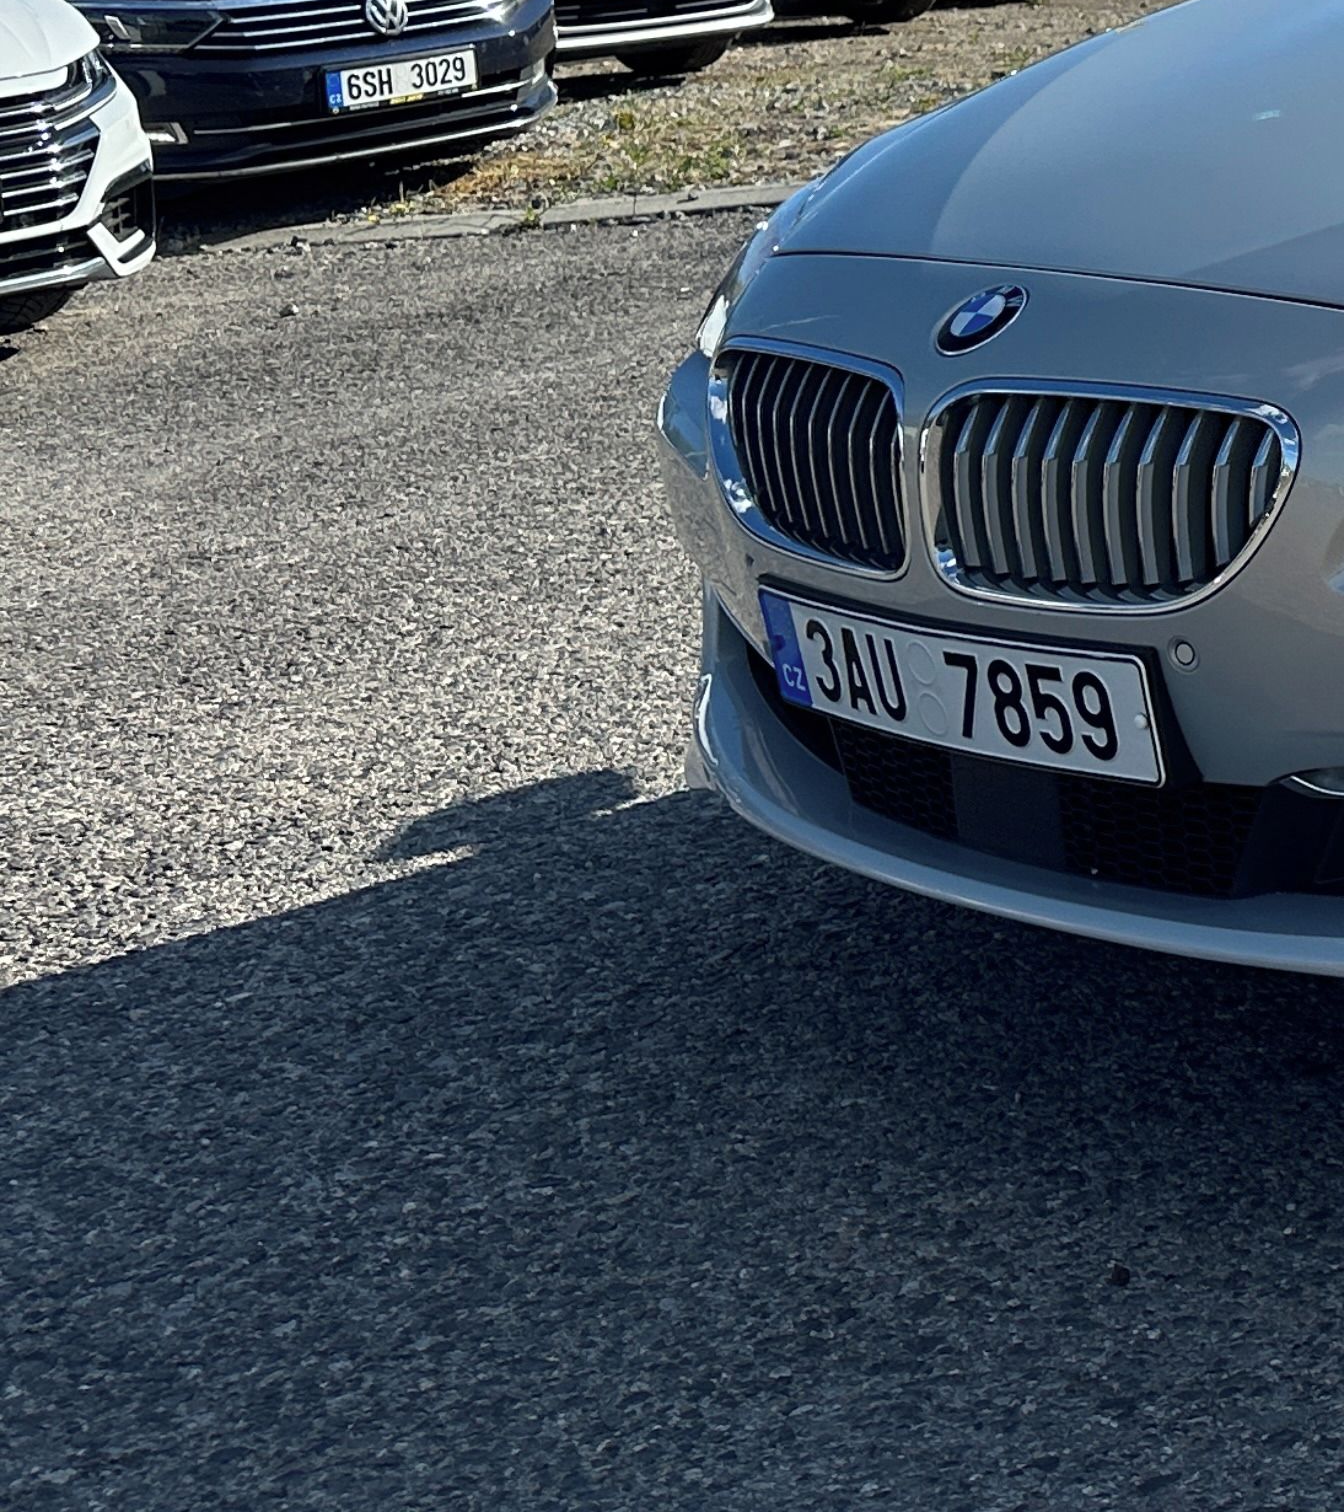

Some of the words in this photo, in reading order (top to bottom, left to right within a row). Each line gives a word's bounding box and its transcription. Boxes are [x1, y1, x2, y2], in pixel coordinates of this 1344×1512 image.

[347, 68, 393, 100] 6SH
[410, 57, 466, 89] 3029
[783, 662, 806, 692] CZ
[806, 619, 907, 722] 3AU
[943, 650, 1118, 761] 7859
